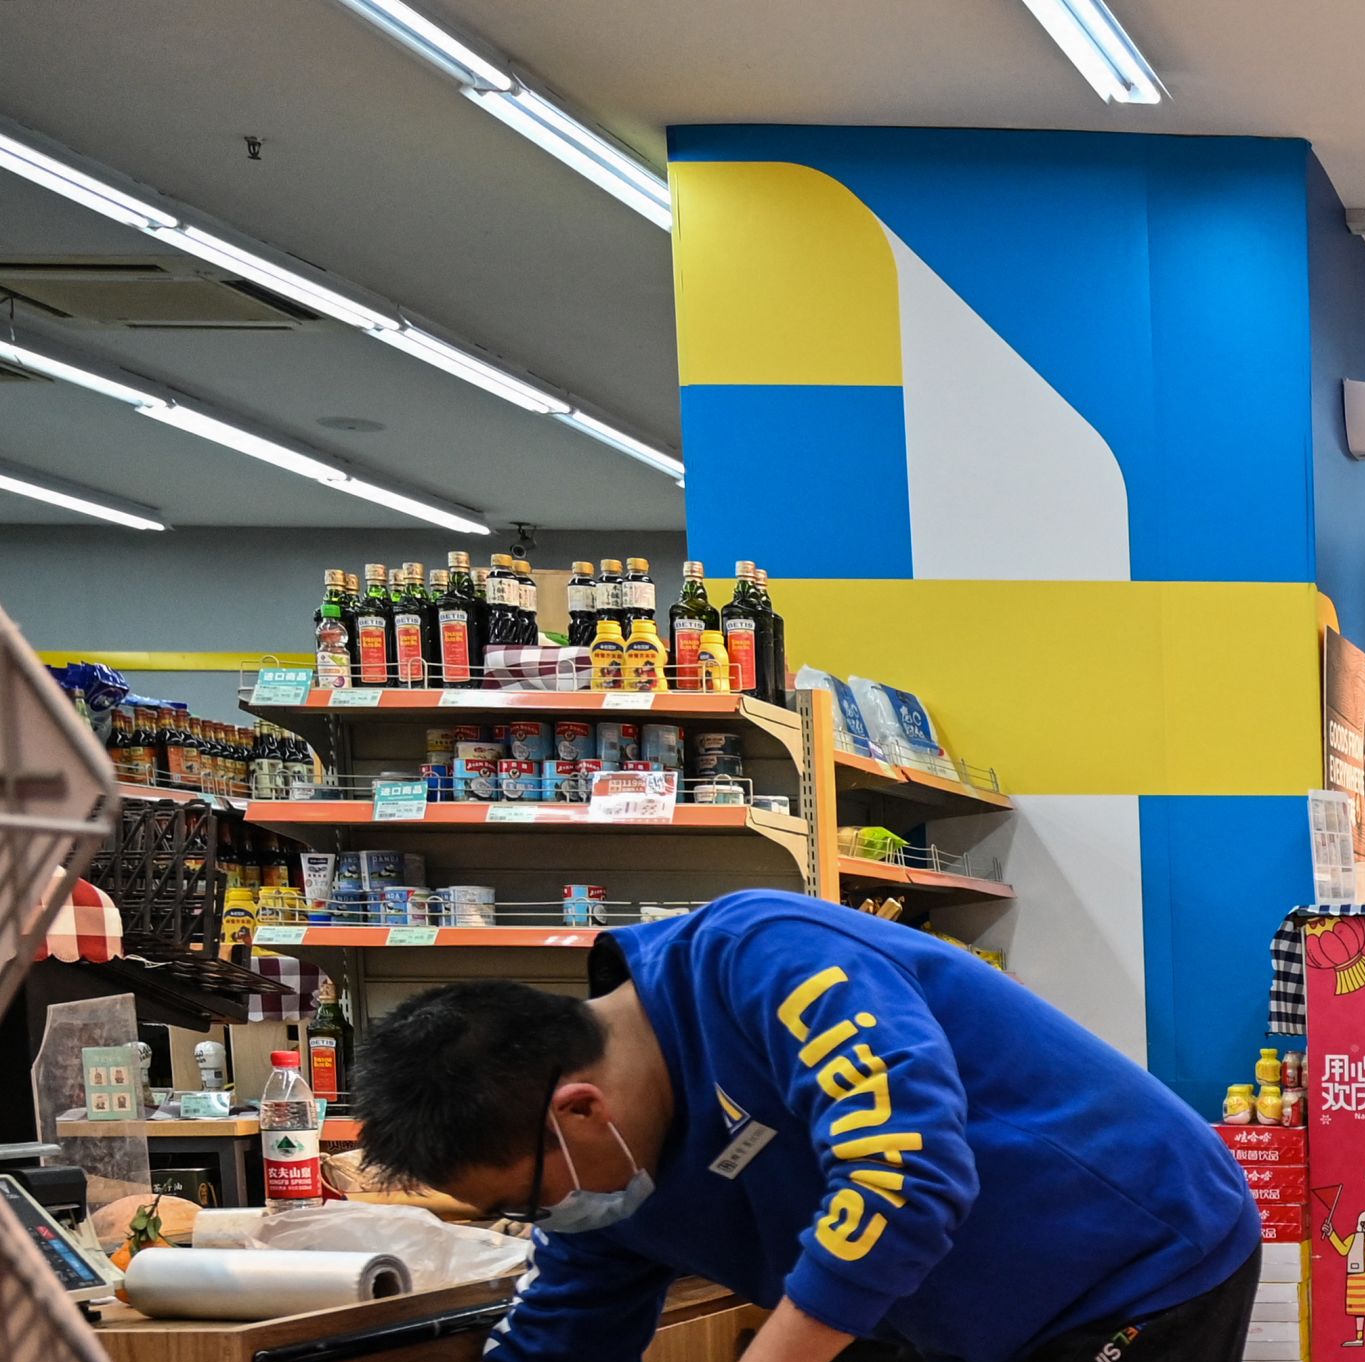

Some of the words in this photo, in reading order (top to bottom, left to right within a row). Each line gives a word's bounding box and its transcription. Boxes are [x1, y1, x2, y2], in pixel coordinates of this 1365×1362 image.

[396, 616, 420, 625] BETIS
[440, 612, 466, 621] BETIS
[359, 618, 384, 627] BETIS
[727, 621, 754, 630] BETIS
[310, 1039, 336, 1048] BETIS
[1234, 1130, 1272, 1143] 娃哈哈
[268, 1167, 311, 1179] 农夫山泉
